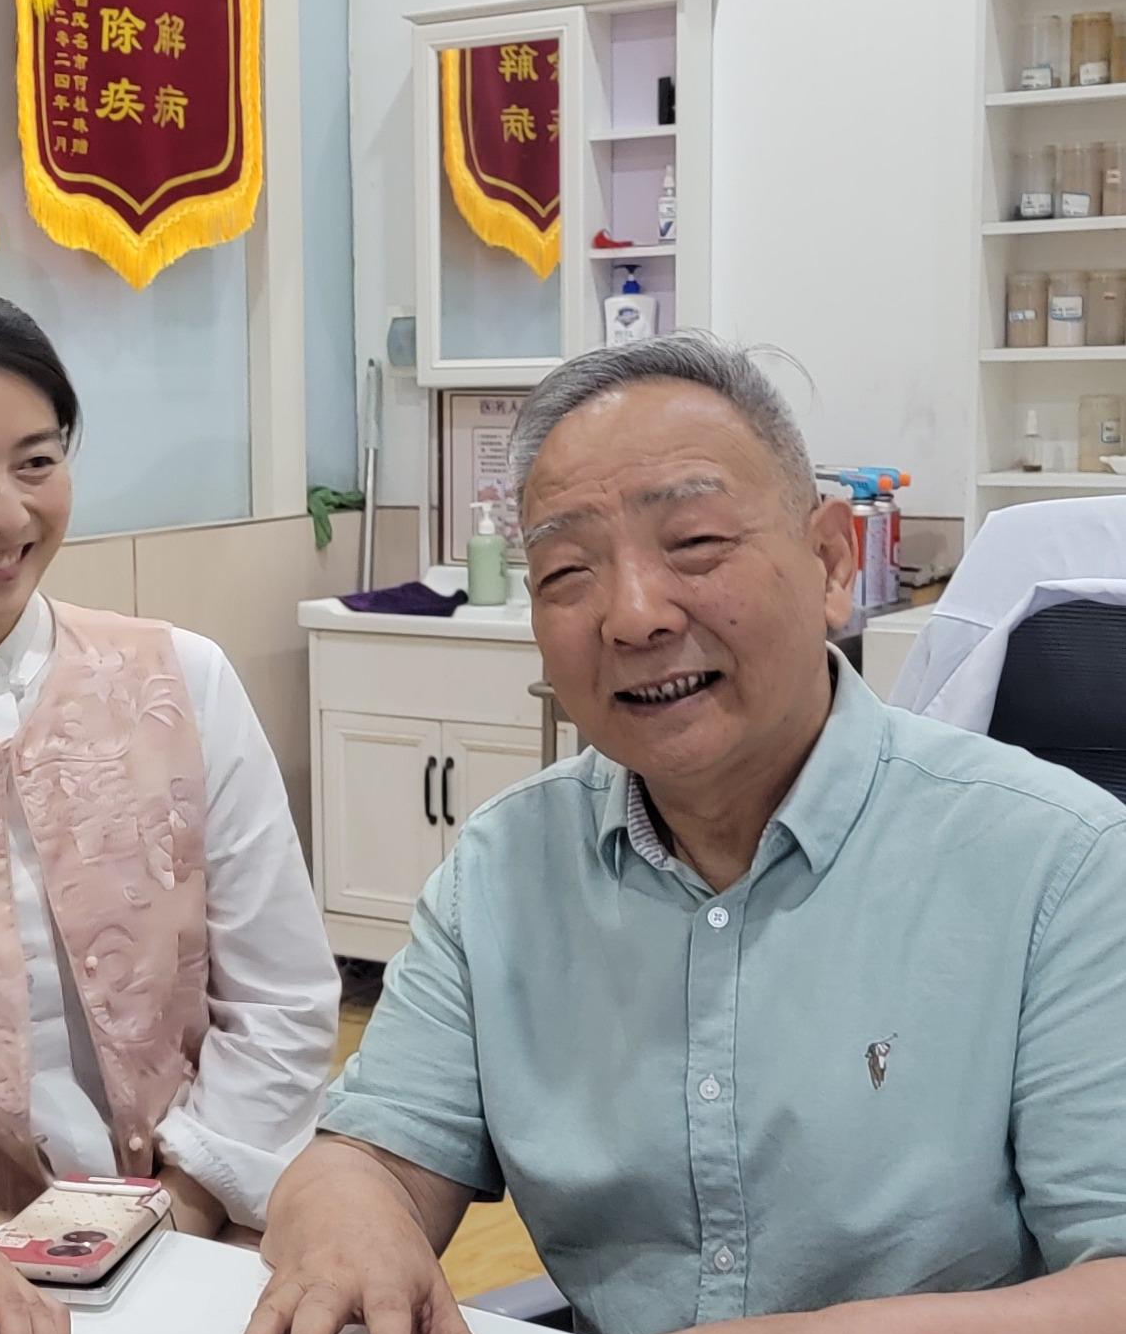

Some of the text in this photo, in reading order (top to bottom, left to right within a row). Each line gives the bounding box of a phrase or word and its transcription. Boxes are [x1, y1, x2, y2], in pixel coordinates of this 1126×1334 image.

[52, 10, 71, 153] 二零二四年一月
